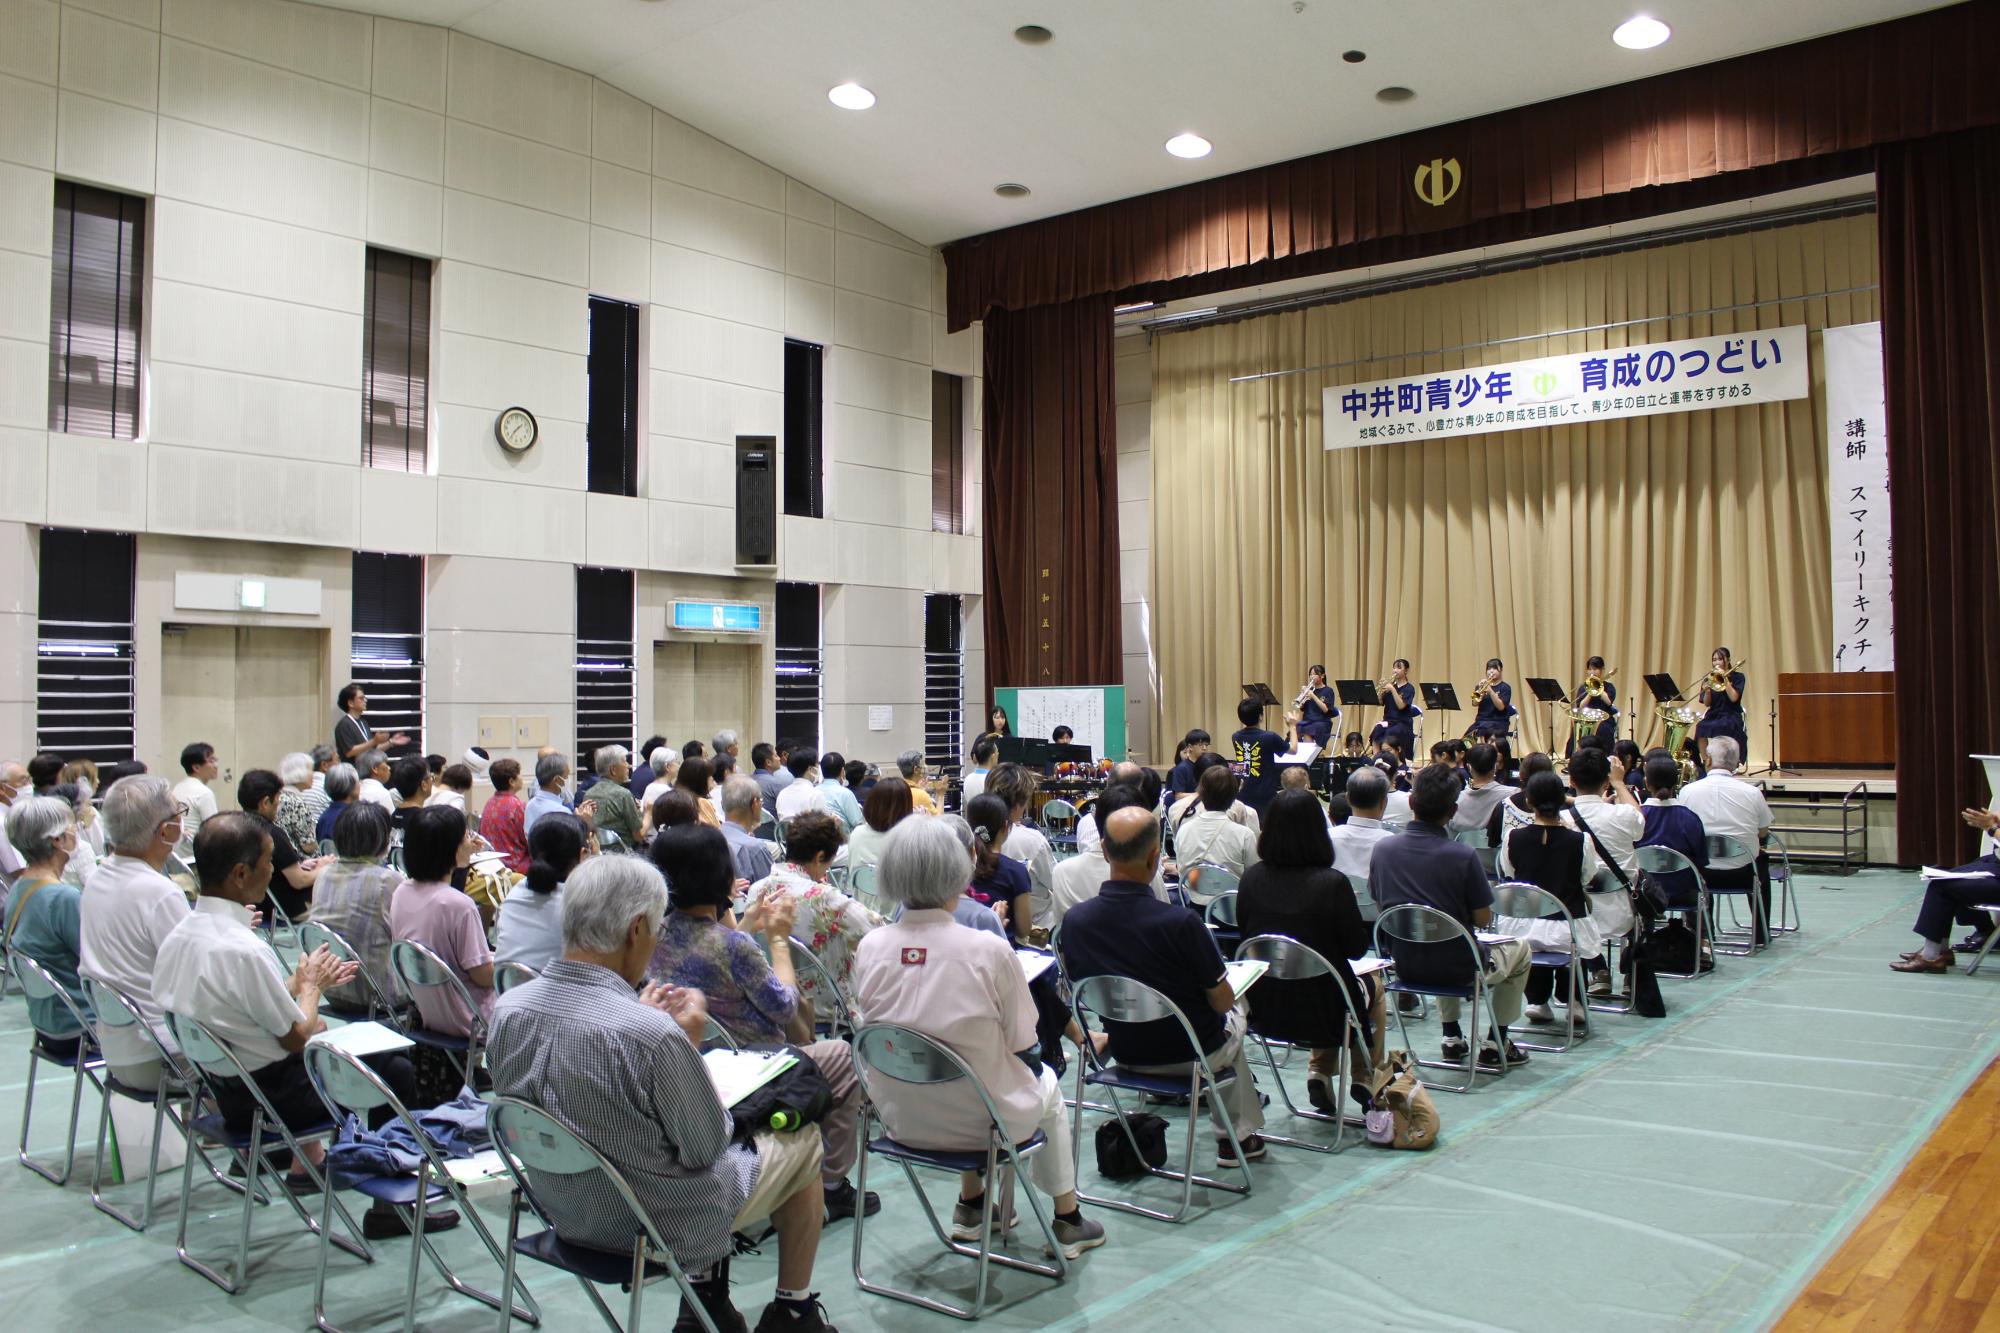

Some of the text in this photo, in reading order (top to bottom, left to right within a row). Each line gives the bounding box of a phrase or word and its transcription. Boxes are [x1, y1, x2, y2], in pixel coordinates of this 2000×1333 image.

[1342, 338, 1782, 421] 中井町青少年 育成のつどい
[1845, 418, 1872, 672] 講師 スマイリーキクチ
